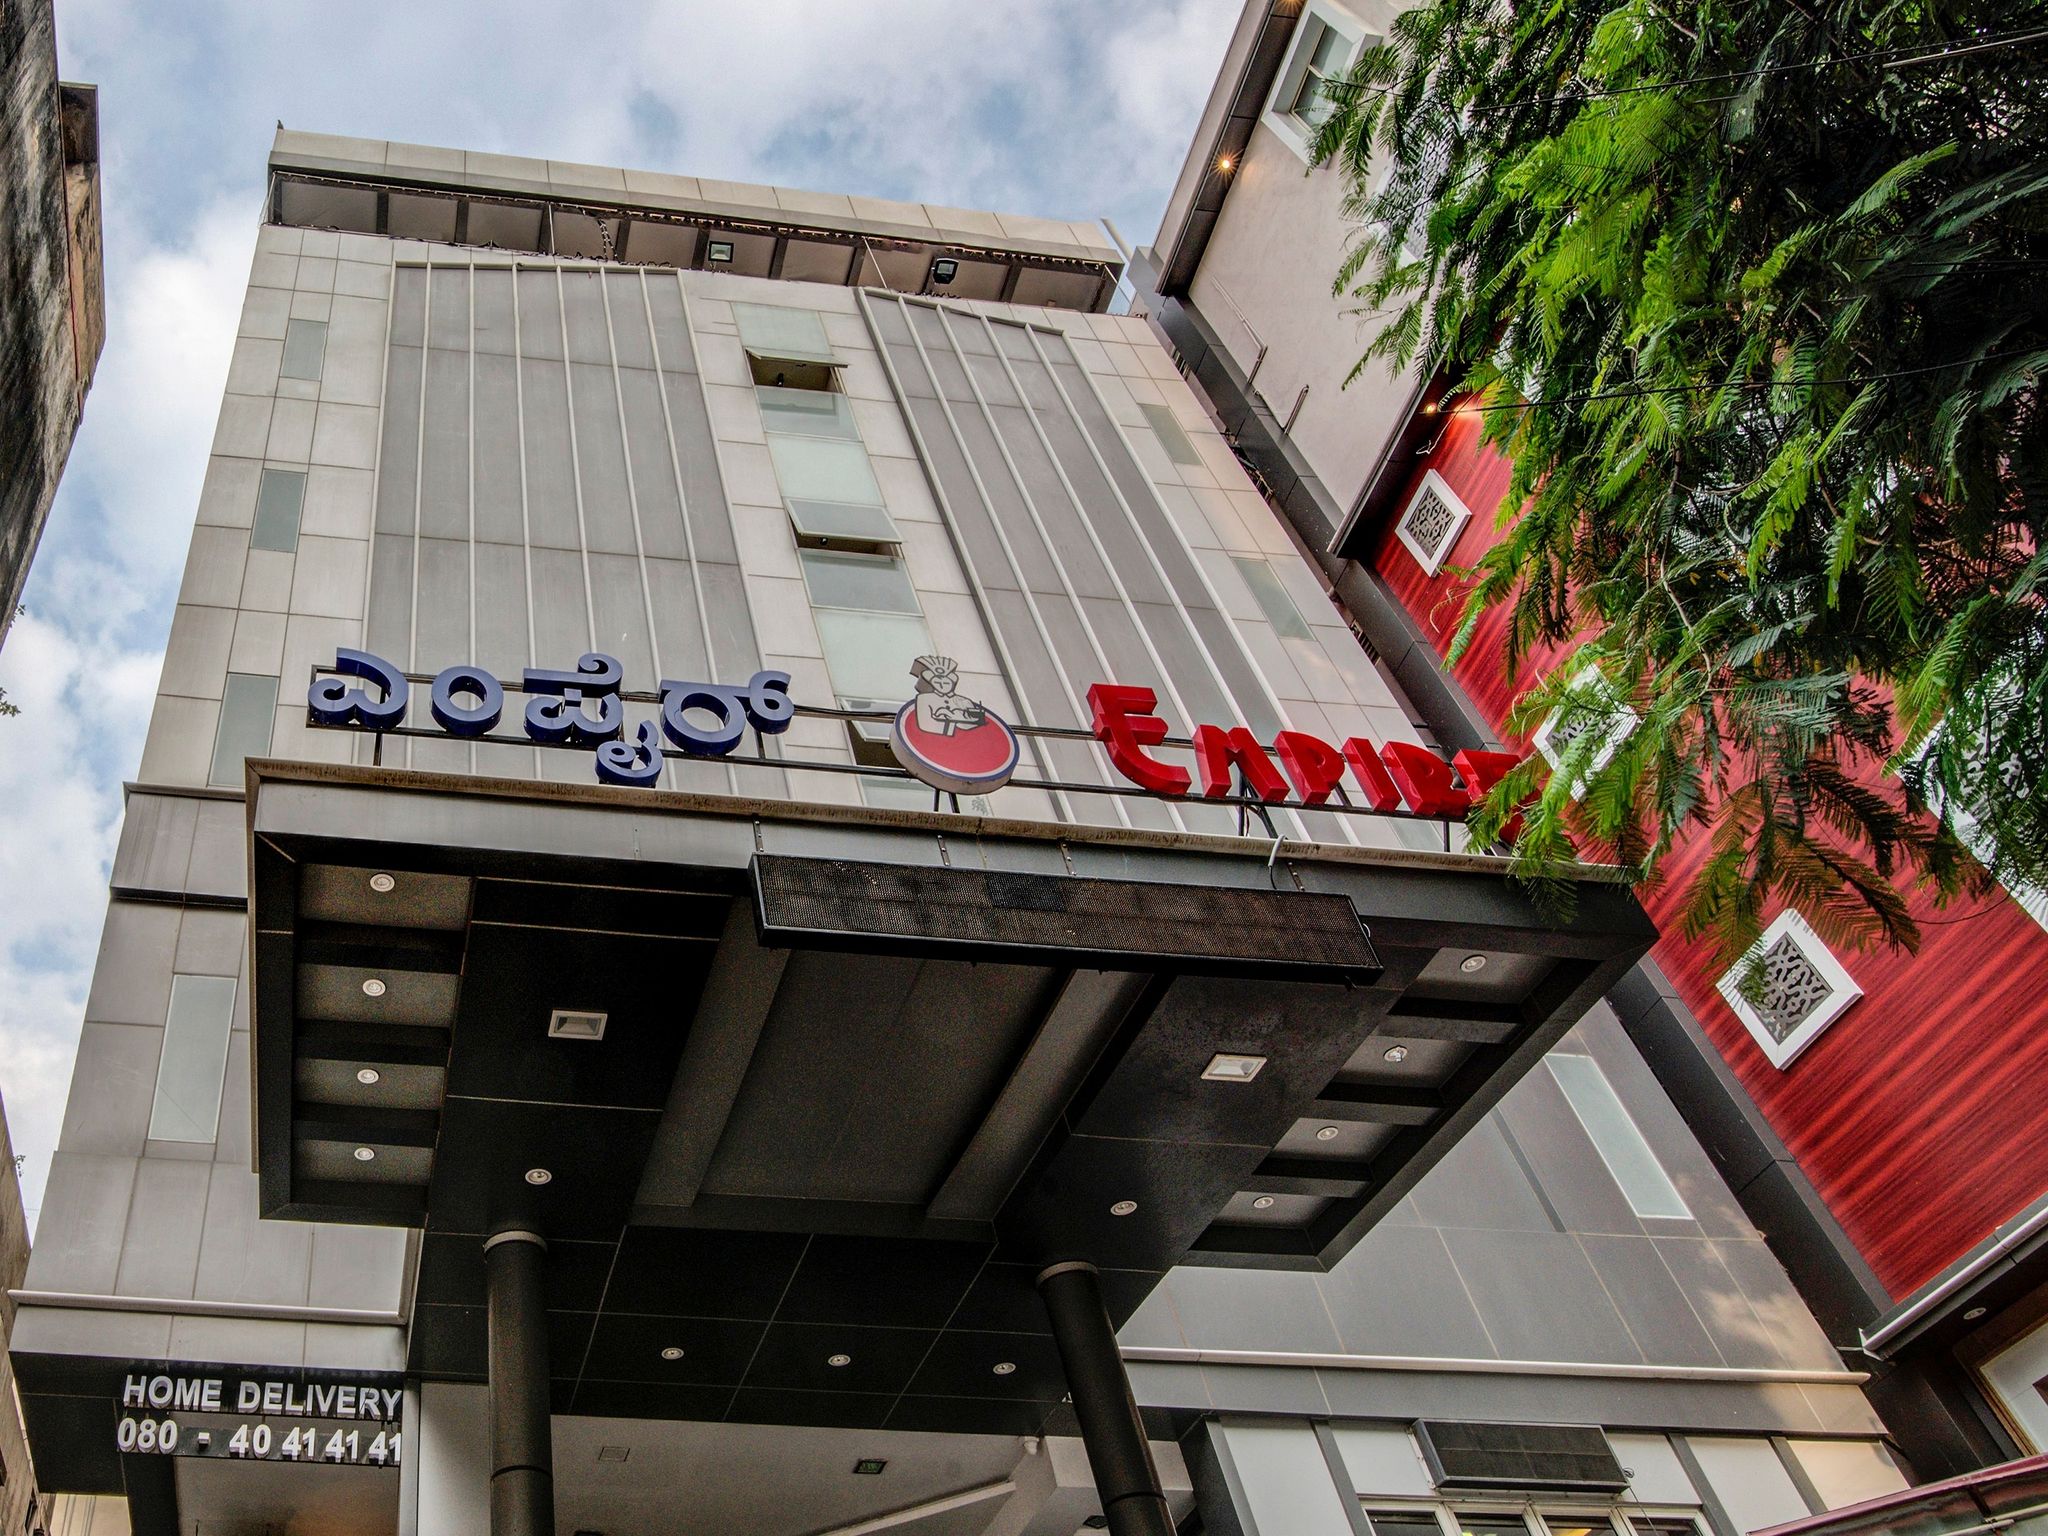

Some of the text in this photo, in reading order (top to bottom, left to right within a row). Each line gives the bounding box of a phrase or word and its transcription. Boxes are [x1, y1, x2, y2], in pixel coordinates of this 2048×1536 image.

[123, 1374, 402, 1420] HOME DELIVERY
[117, 1417, 178, 1453] 080
[229, 1424, 271, 1458] 40
[282, 1427, 316, 1460] 41
[325, 1429, 359, 1463] 41
[368, 1431, 402, 1465] 41
